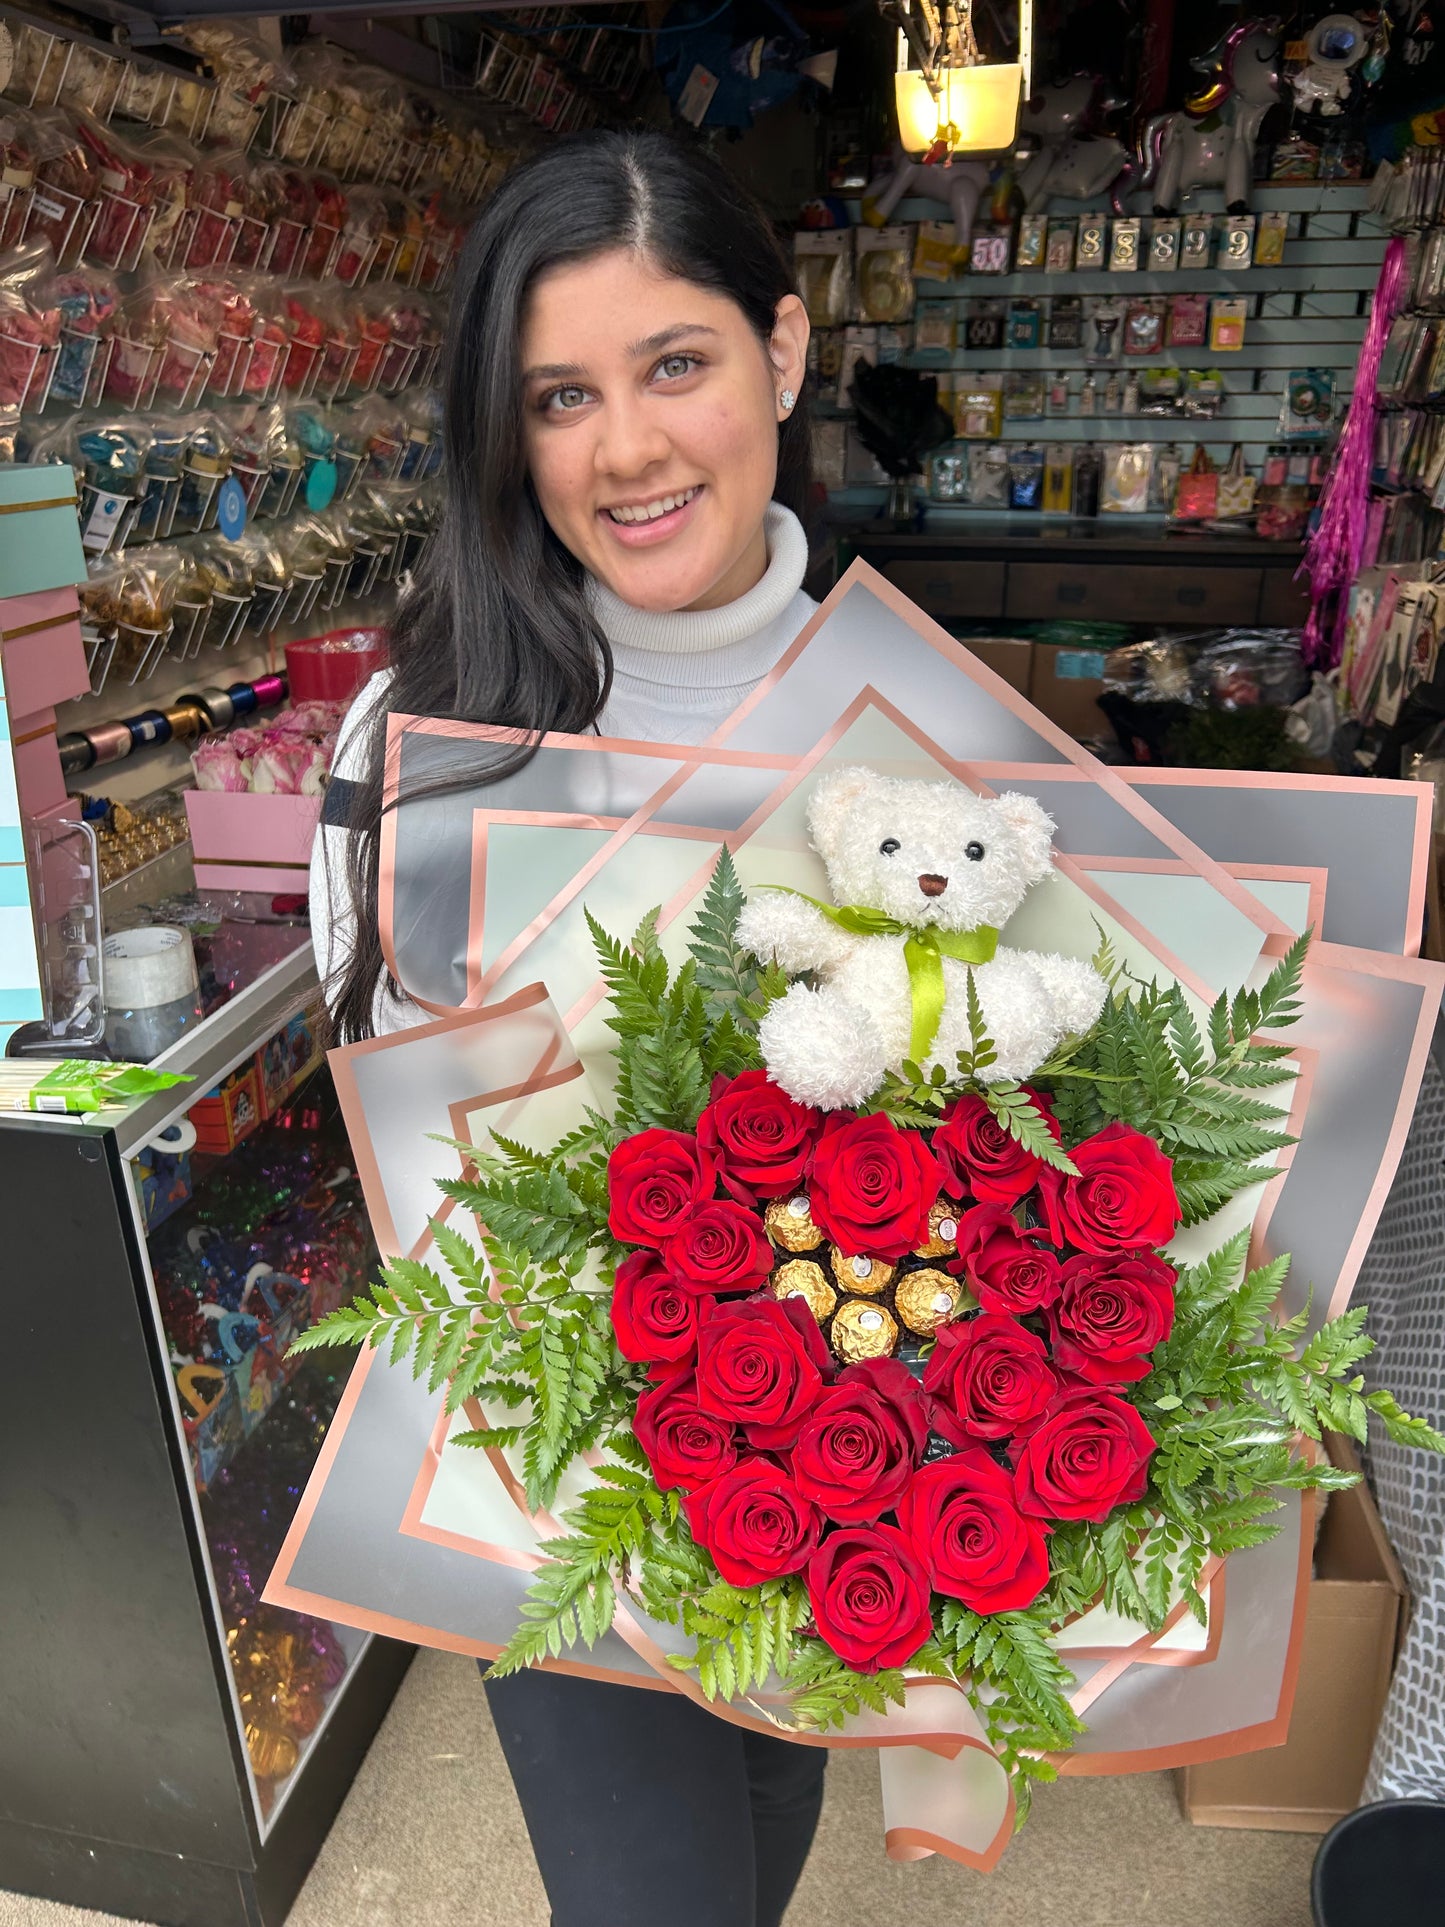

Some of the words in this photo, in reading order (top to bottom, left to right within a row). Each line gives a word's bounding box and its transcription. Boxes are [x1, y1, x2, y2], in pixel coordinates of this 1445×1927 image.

[972, 238, 1007, 267] 50
[1081, 229, 1100, 254] 8
[1114, 232, 1133, 258] 8
[1154, 233, 1174, 258] 8
[1185, 230, 1205, 255] 9
[1228, 230, 1249, 256] 9
